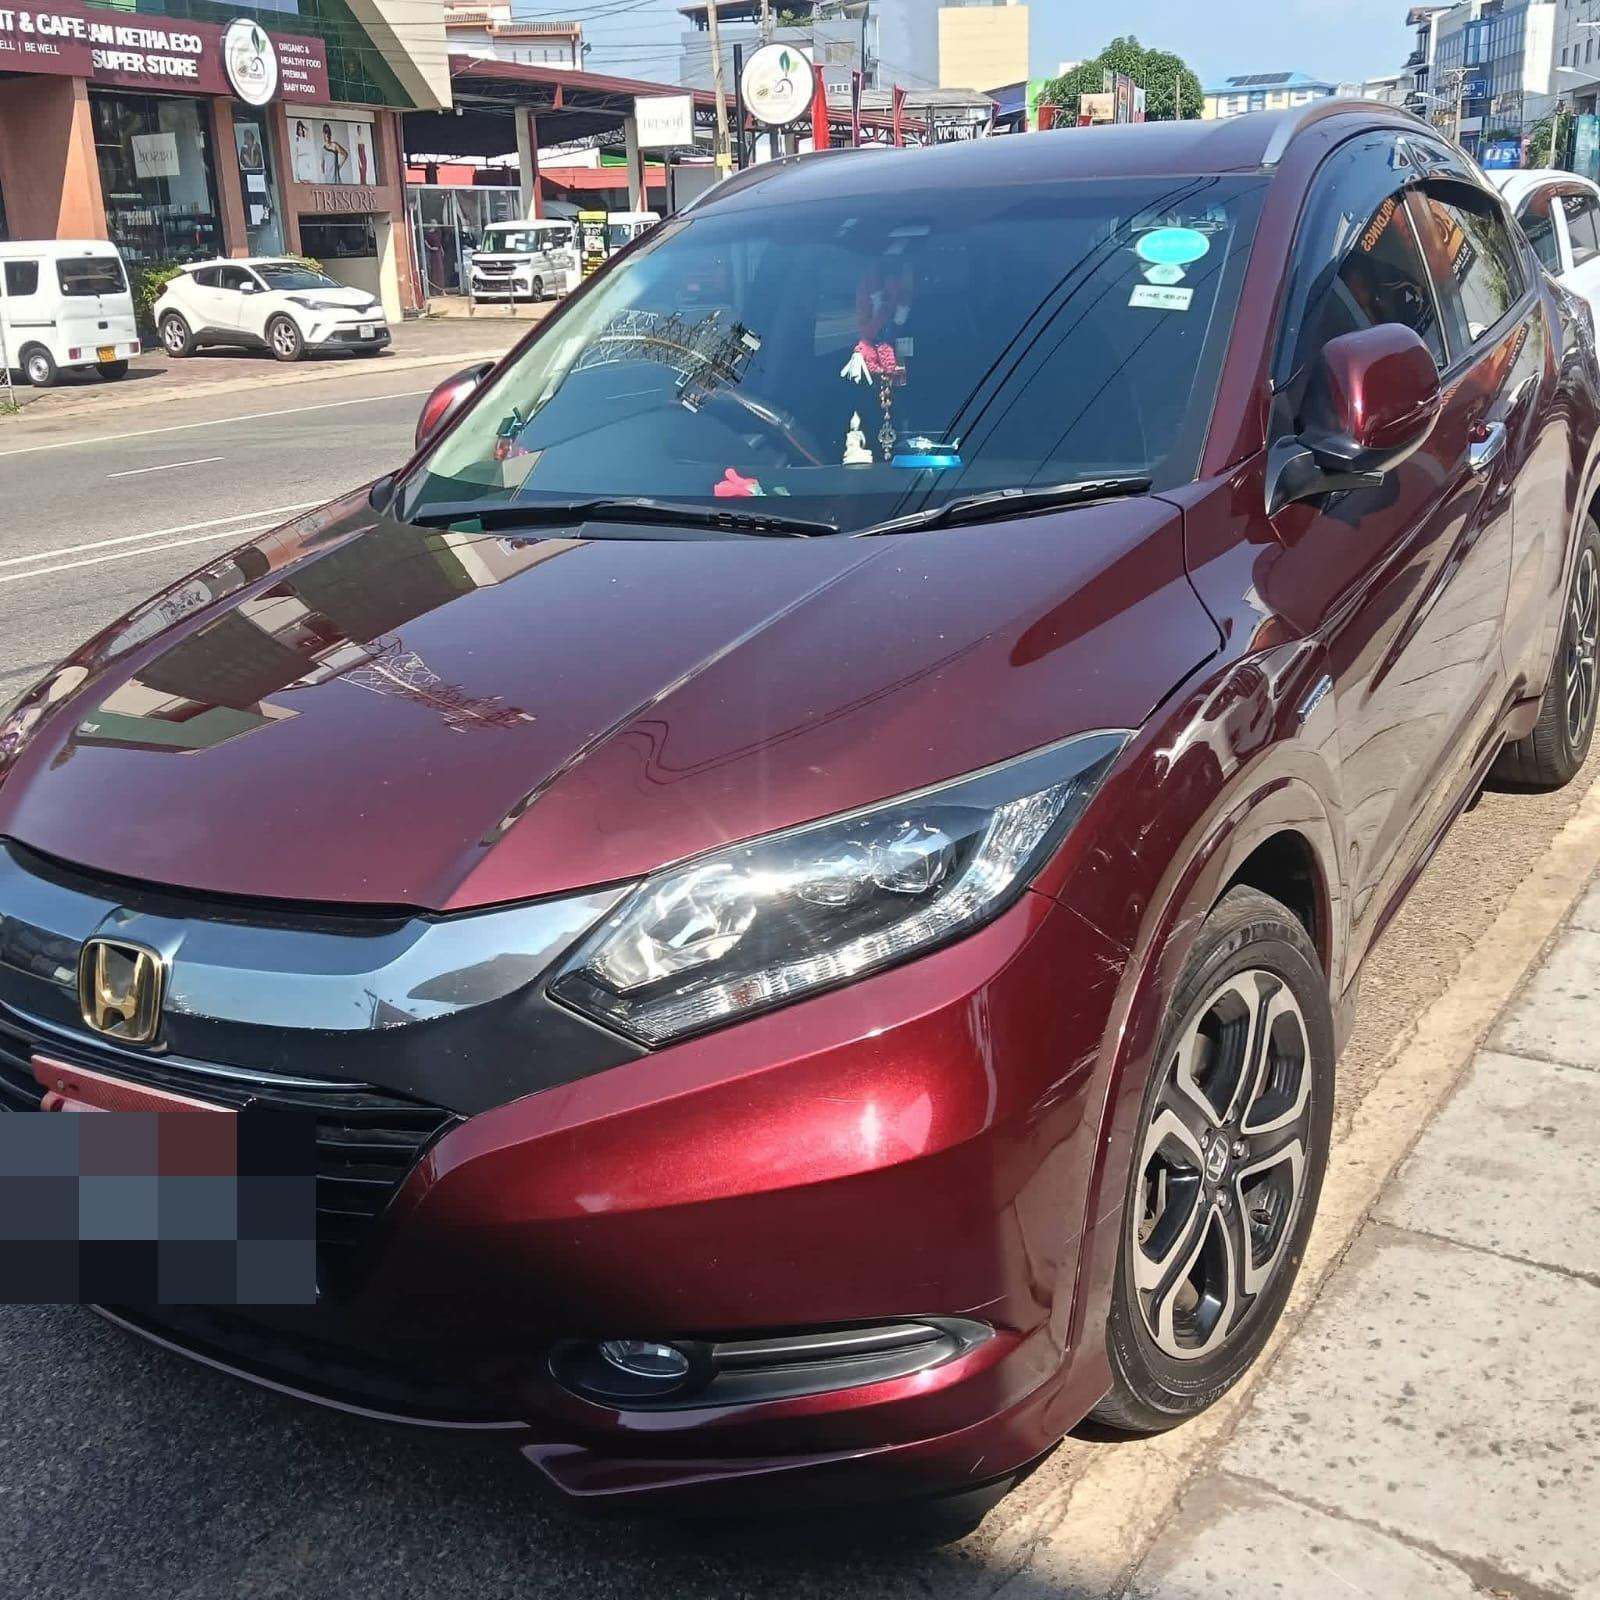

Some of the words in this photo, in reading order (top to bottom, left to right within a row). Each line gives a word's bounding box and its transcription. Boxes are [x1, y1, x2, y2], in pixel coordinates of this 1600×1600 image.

[19, 12, 35, 33] &
[36, 13, 87, 39] CAFE
[115, 26, 170, 50] KETHA
[169, 32, 202, 54] ECO
[24, 42, 36, 52] BE
[37, 44, 60, 55] WELL
[278, 43, 304, 54] ORGANIC
[91, 49, 146, 73] SUPER
[146, 55, 198, 77] STORE
[280, 56, 306, 66] HEALTHY
[306, 60, 322, 69] FOOD
[282, 69, 308, 80] PREMIUM
[283, 83, 299, 92] BABY
[299, 84, 316, 93] FOOD
[937, 125, 974, 141] VICTORY
